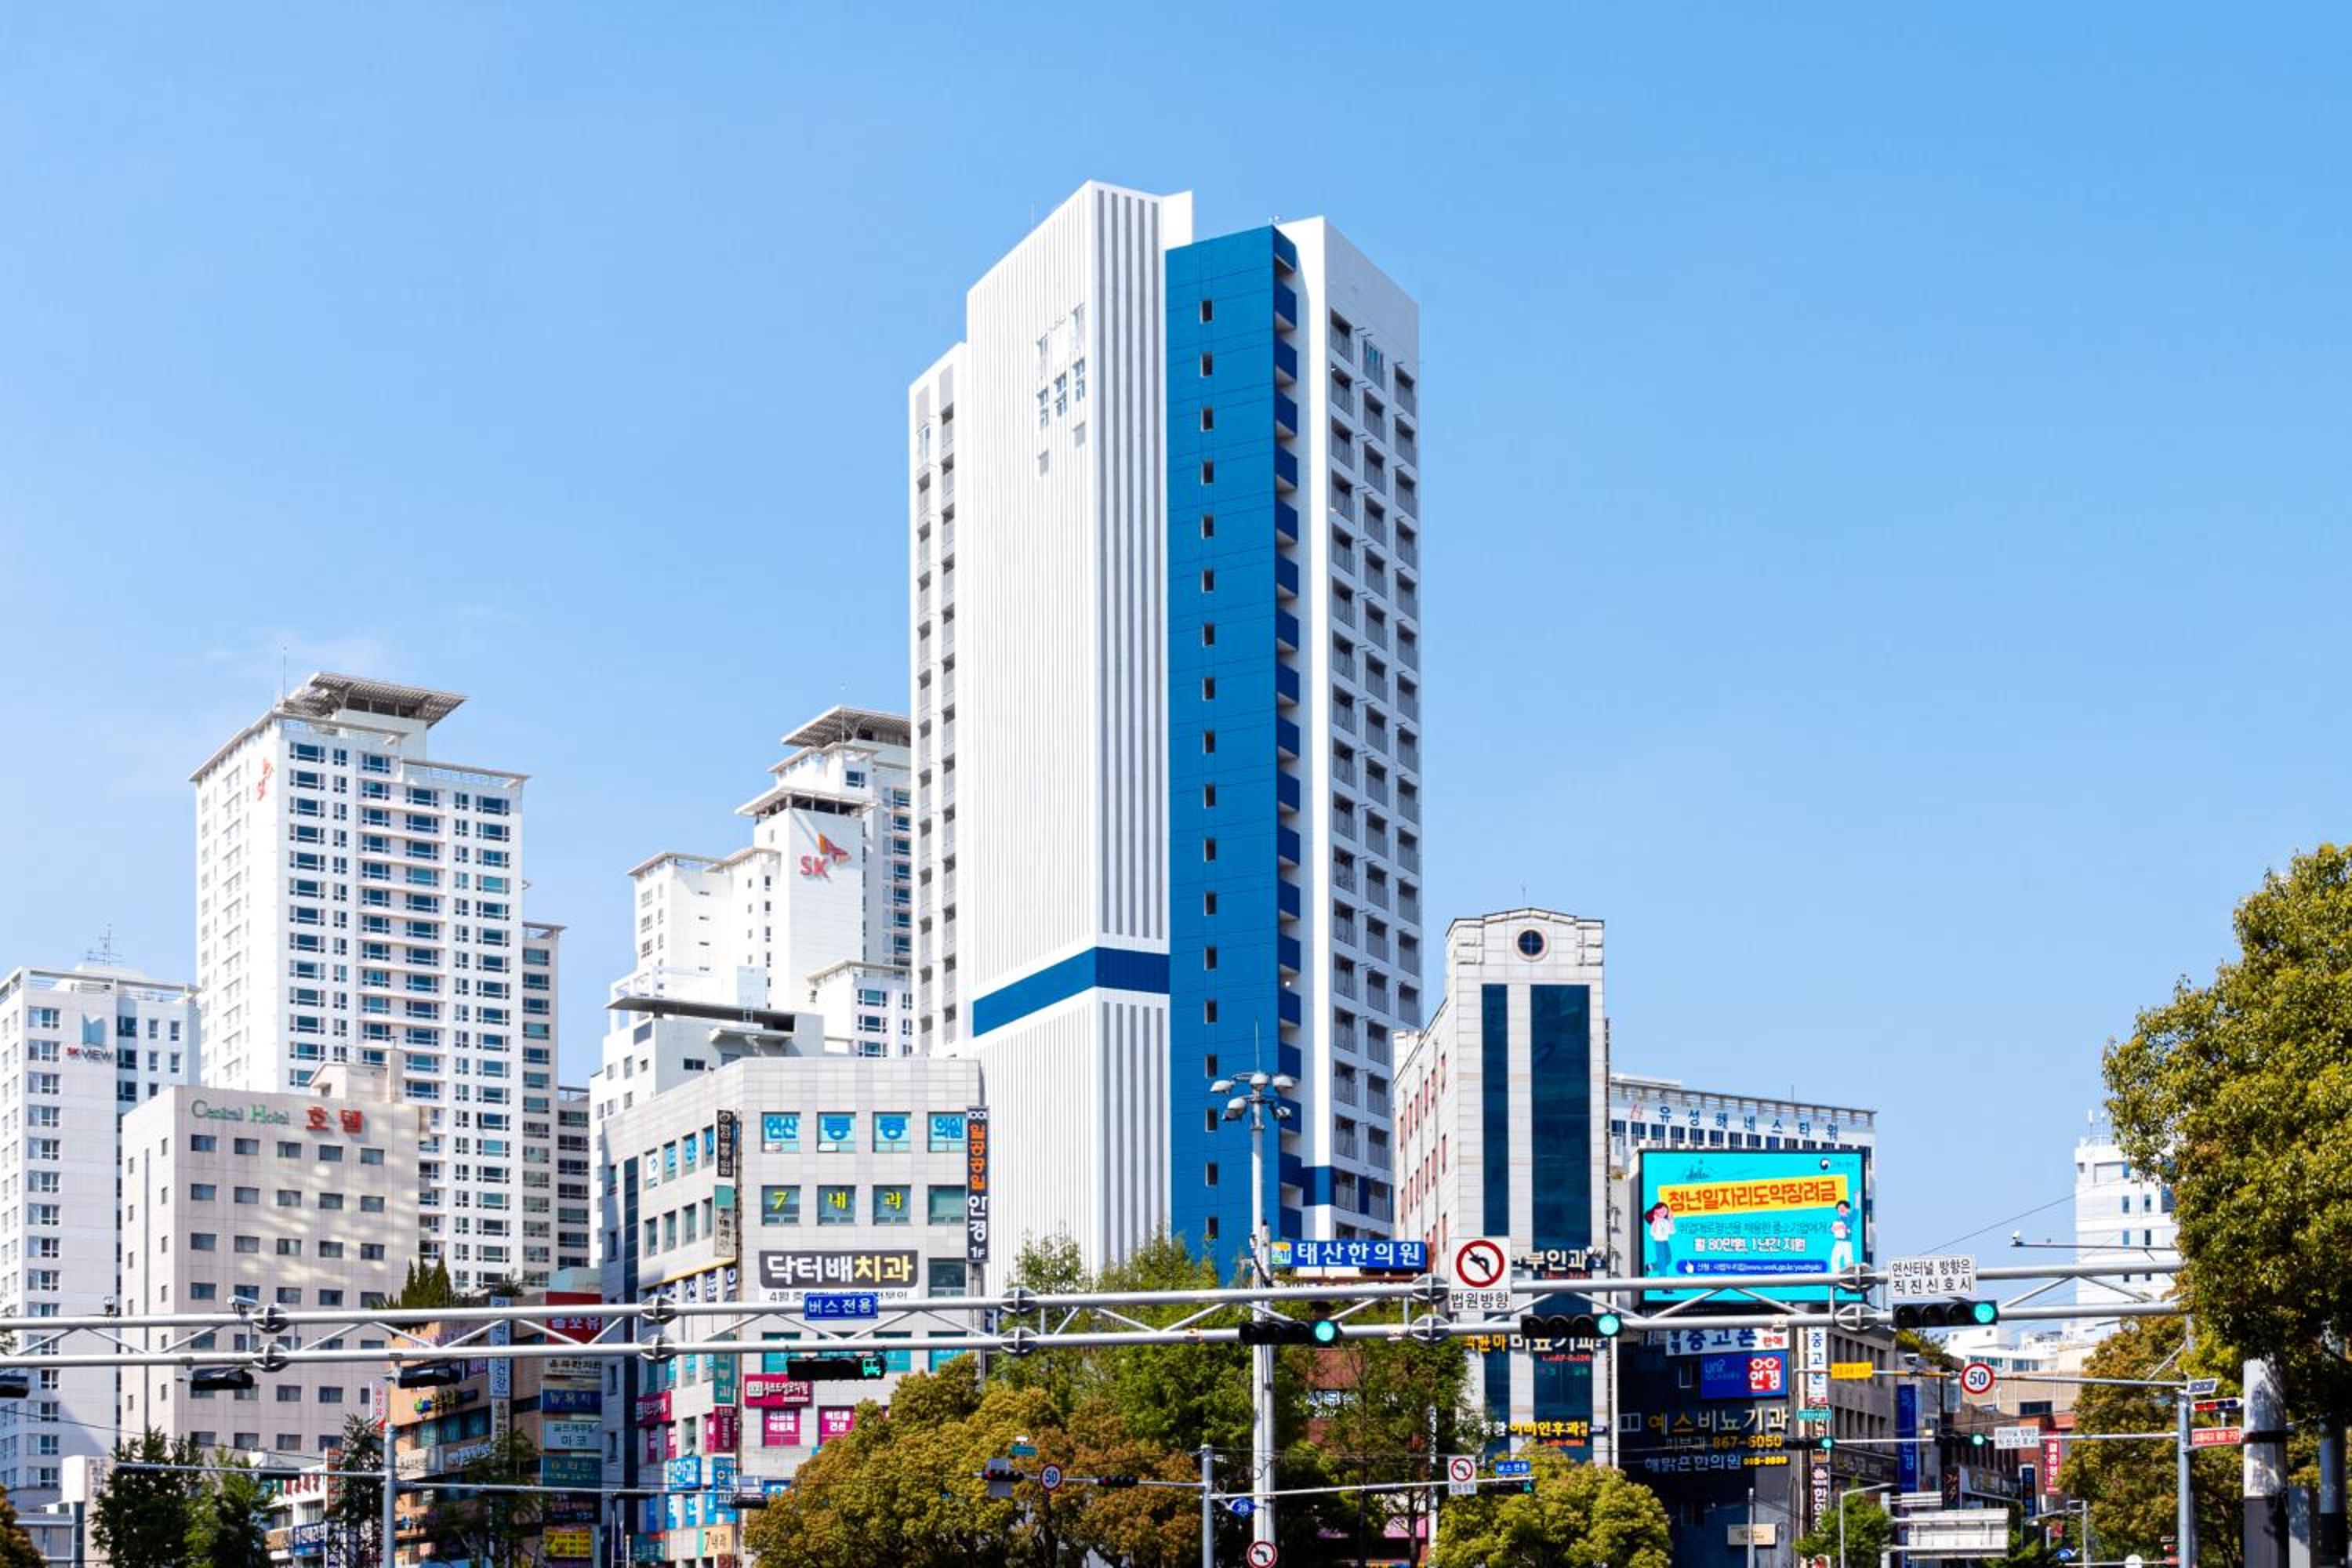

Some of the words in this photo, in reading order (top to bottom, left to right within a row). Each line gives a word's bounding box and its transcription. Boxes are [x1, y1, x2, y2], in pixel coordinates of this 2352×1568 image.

[800, 855, 829, 880] SK
[81, 1047, 113, 1061] VIEW
[191, 1099, 243, 1122] Central
[249, 1104, 291, 1125] Hotel
[1668, 1180, 1838, 1212] 청년일자리도약장려금
[971, 1247, 986, 1258] 1F
[1297, 1242, 1421, 1266] 태산한의원
[767, 1255, 913, 1285] 닥터배치과
[1892, 1257, 1934, 1277] 연산터널
[1939, 1254, 1970, 1275] 방향은
[1893, 1273, 1973, 1295] 직진신호시
[808, 1297, 873, 1314] 버스전용
[1451, 1293, 1508, 1308] 법원방향
[1749, 1370, 1780, 1391] 안경
[1969, 1370, 1987, 1385] 50
[1647, 1406, 1790, 1436] 예스비뇨기과
[1045, 1470, 1058, 1484] 50
